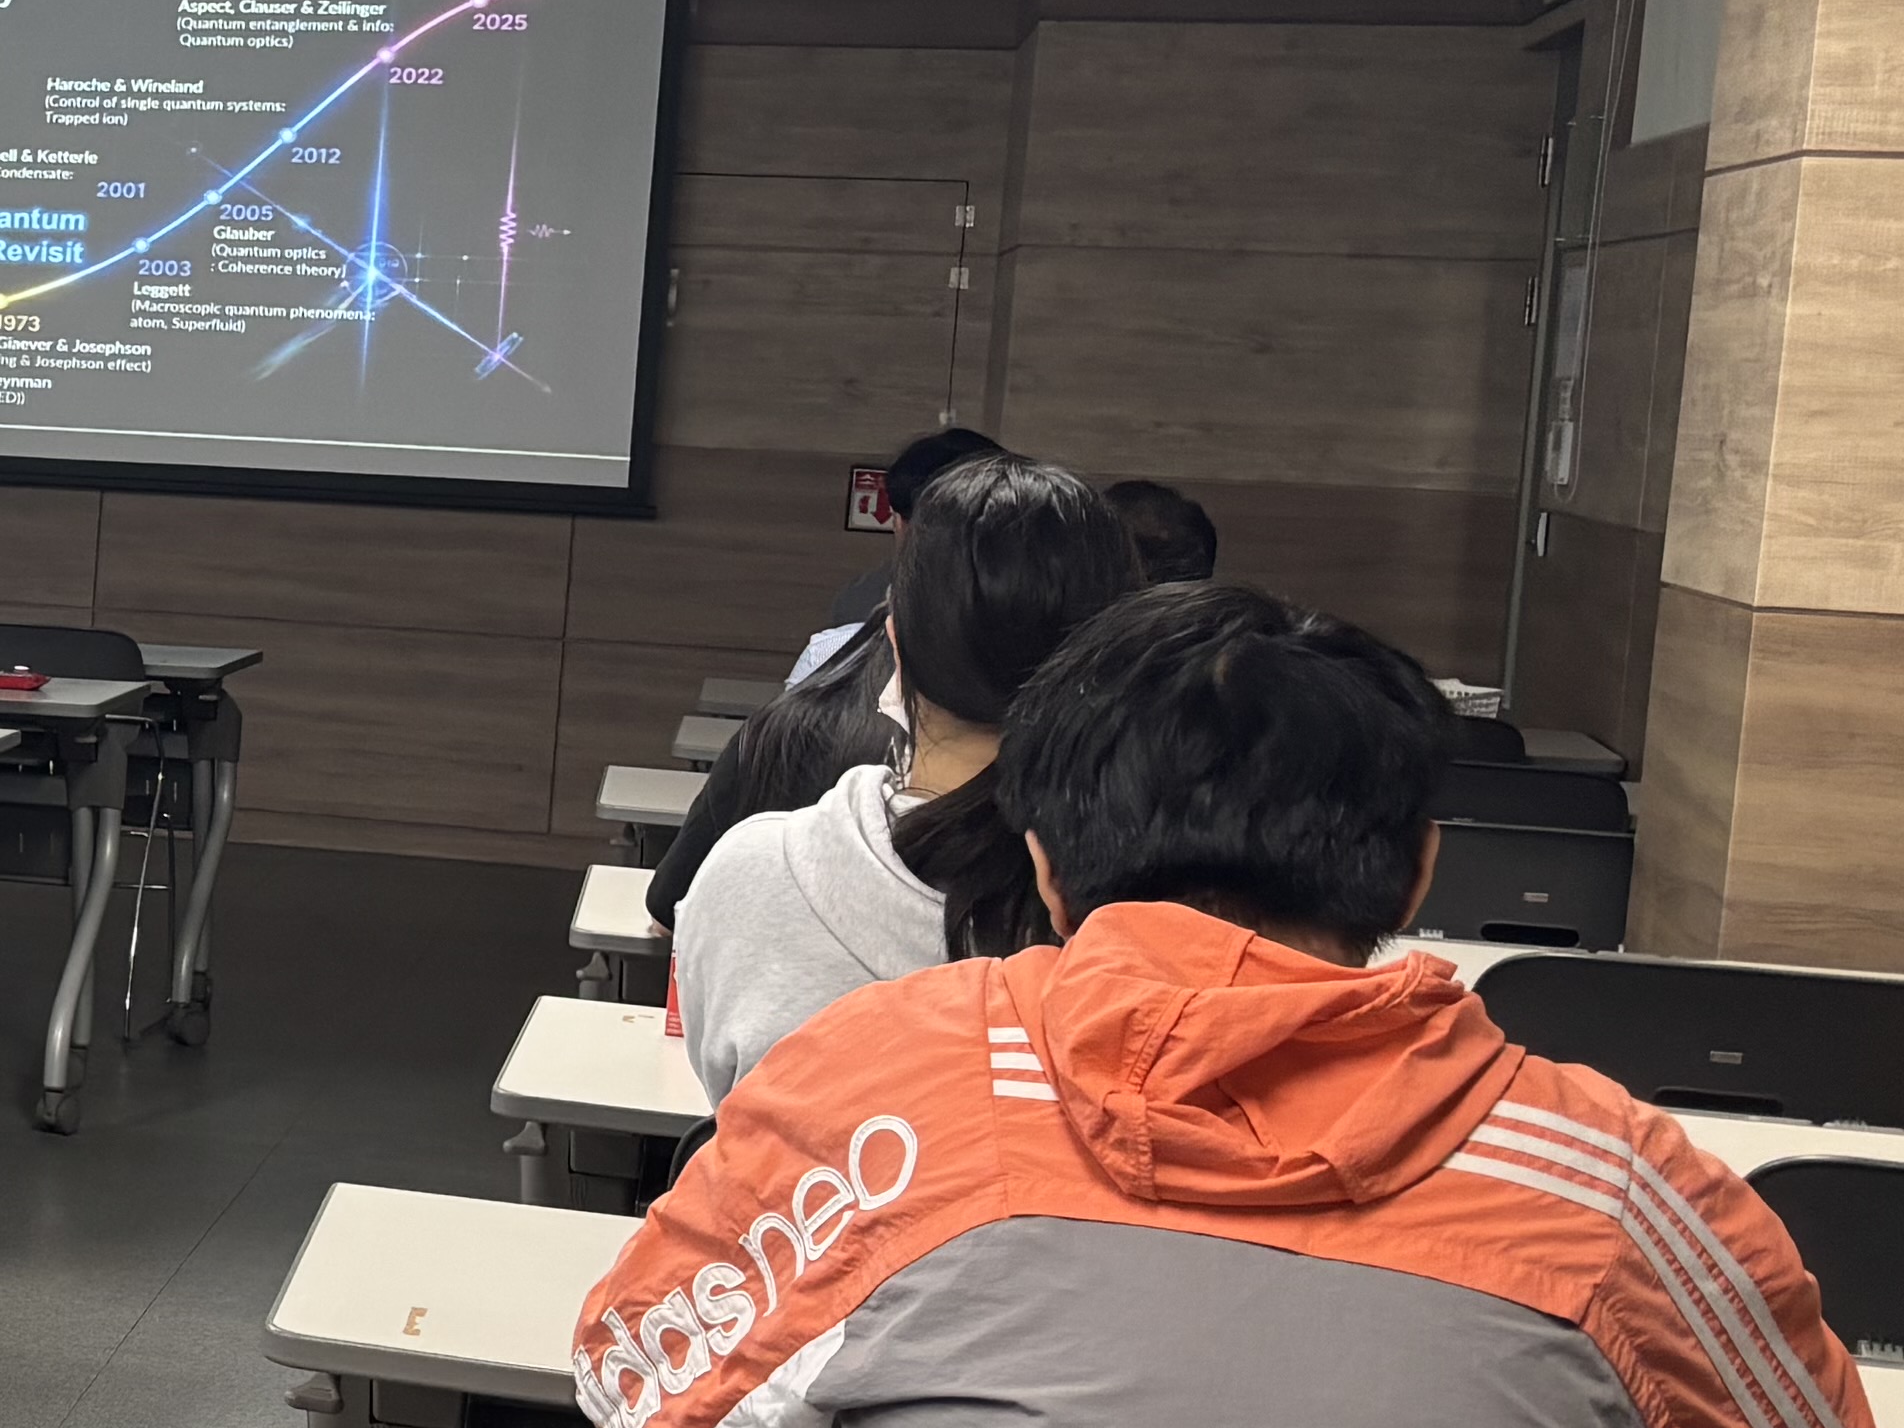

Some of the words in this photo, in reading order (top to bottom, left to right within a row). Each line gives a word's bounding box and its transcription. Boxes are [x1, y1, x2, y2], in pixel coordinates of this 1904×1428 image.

[239, 0, 298, 15] Clauser
[301, 1, 314, 14] &
[317, 0, 387, 17] Zeilinger
[176, 17, 245, 31] (Quantum
[249, 18, 344, 33] entanglement
[347, 20, 359, 32] &
[362, 19, 395, 33] info:
[472, 13, 528, 30] 2025
[179, 34, 243, 47] Quantum
[247, 35, 294, 49] optics)
[389, 67, 444, 84] 2022
[46, 77, 110, 92] Haroche
[114, 79, 126, 92] &
[131, 79, 204, 94] Wineland
[45, 95, 100, 109] (Control
[103, 96, 118, 109] of
[120, 97, 160, 112] single
[163, 100, 223, 112] quantum
[226, 100, 286, 113] systems:
[45, 111, 100, 126] Trapped
[102, 112, 129, 126] ion)
[21, 149, 33, 163] &
[37, 149, 99, 165] Ketterle
[291, 147, 341, 164] 2012
[96, 181, 147, 198] 2001
[219, 204, 274, 221] 2005
[213, 226, 275, 242] Glauber
[212, 243, 281, 259] (Quantum
[285, 245, 327, 260] optics
[138, 259, 192, 277] 2003
[218, 260, 293, 276] Coherence
[296, 262, 346, 278] theory)
[133, 281, 191, 298] Leggett
[131, 299, 221, 316] (Macroscopic
[225, 304, 287, 318] quantum
[290, 306, 376, 321] phenomena:
[130, 318, 168, 330] atom,
[172, 318, 246, 333] Superfluid)
[56, 338, 68, 352] &
[72, 339, 152, 357] Josephson
[20, 355, 30, 367] &
[35, 355, 104, 371] Josephson
[107, 356, 152, 373] effect)
